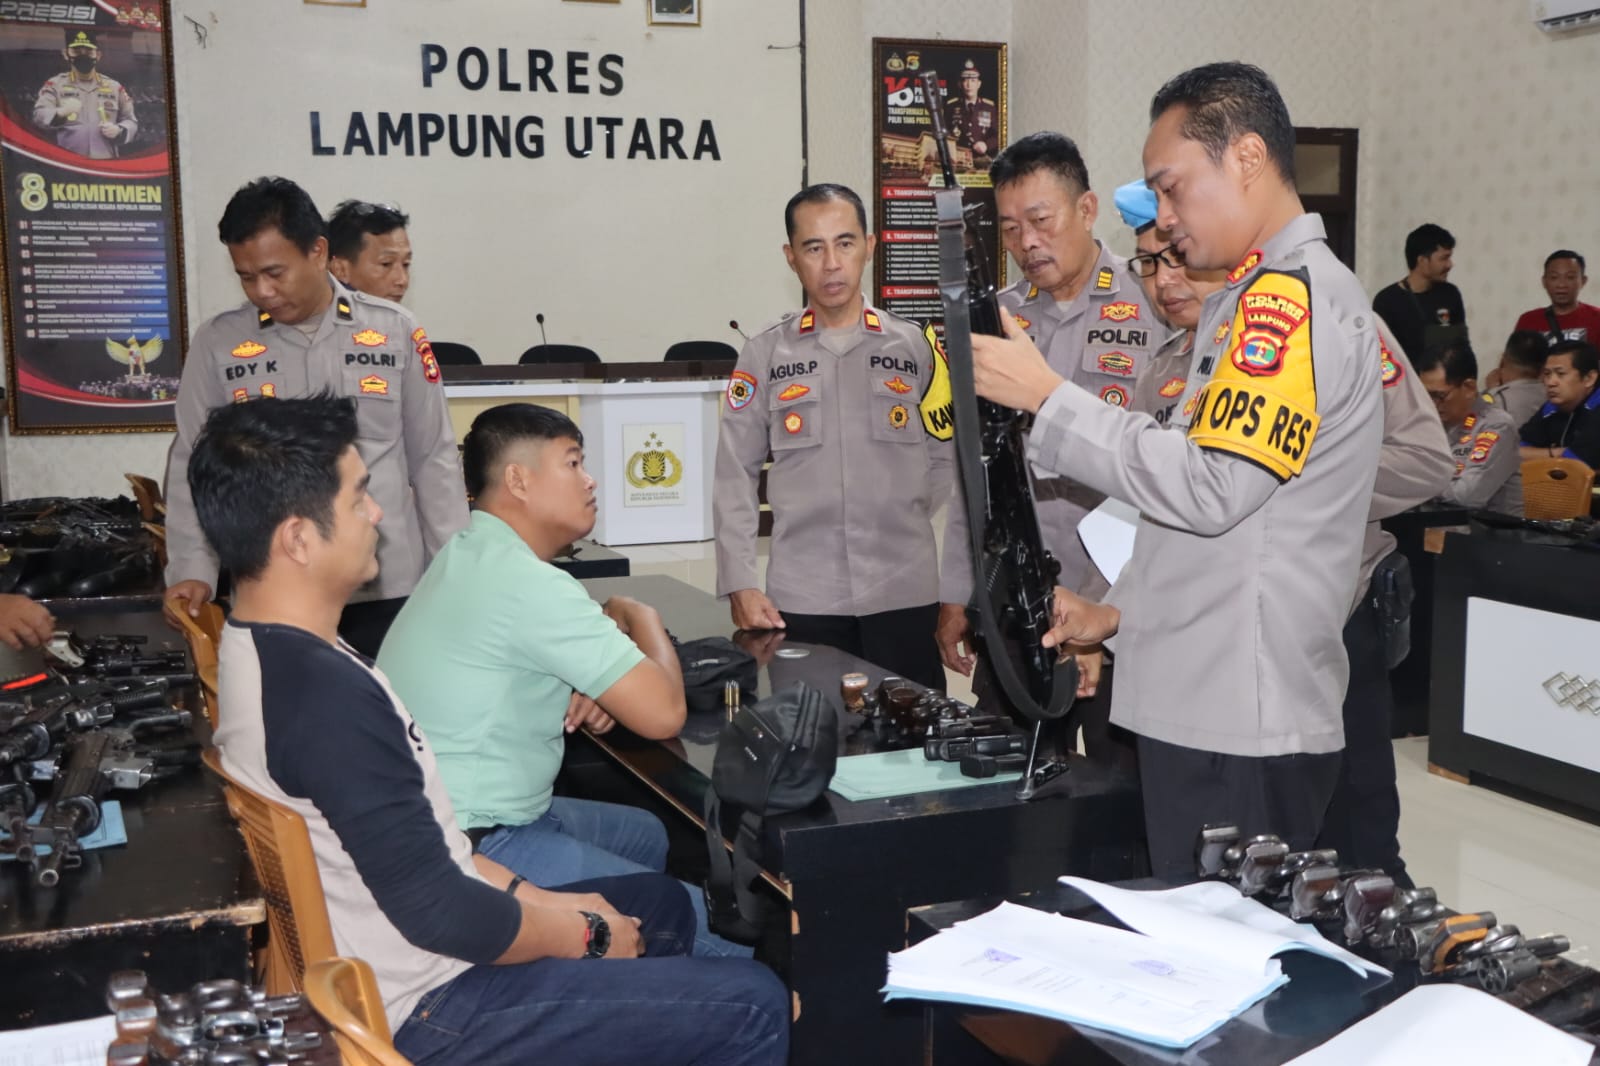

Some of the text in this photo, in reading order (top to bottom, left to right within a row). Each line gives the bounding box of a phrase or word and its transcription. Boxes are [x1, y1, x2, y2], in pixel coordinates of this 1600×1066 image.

[0, 1, 96, 20] PRESISI
[421, 44, 624, 96] POLRES
[310, 111, 722, 161] LAMPUNG UTARA
[21, 173, 48, 211] 8
[52, 184, 162, 203] KOMITMEN
[1248, 313, 1291, 332] LAMPUNG
[1088, 329, 1148, 347] POLRI
[226, 360, 278, 381] EDY K
[345, 353, 396, 367] POLRI
[769, 360, 818, 381] AGUS.P
[870, 355, 918, 376] POLRI
[1210, 387, 1266, 437] OPS
[1267, 405, 1312, 461] RES
